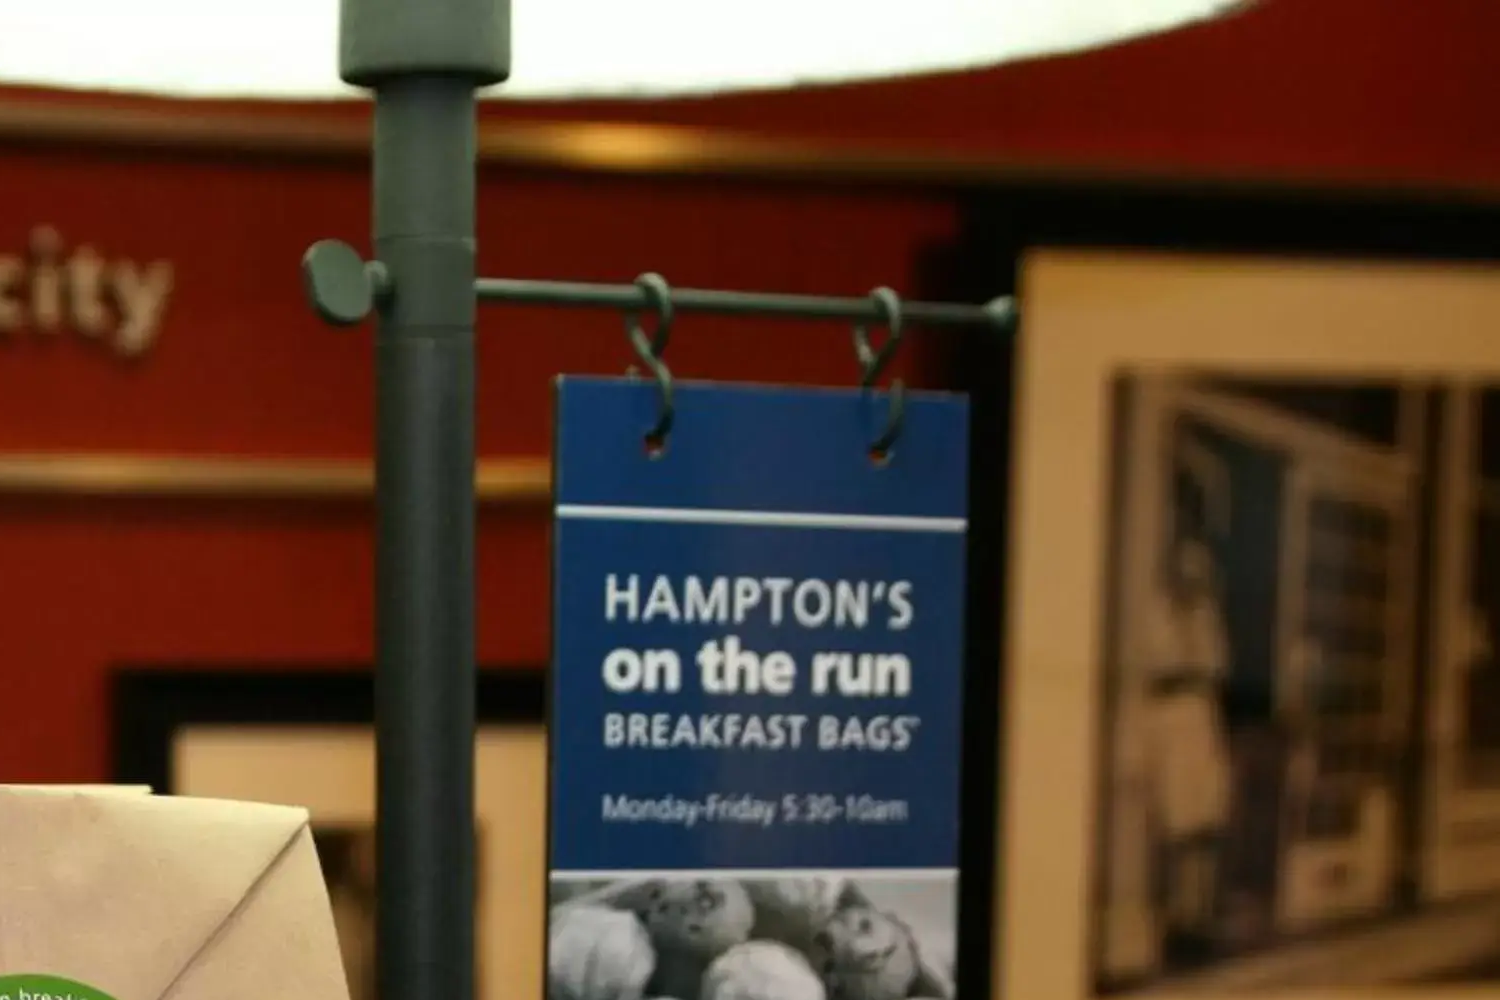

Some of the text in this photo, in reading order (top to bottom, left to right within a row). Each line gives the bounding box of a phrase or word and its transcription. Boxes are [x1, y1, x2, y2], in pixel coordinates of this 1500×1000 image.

[604, 573, 914, 631] HAMPTON'S
[602, 635, 912, 697] on the run
[604, 712, 808, 750] BREAKFAST
[602, 793, 777, 829] Monday-Friday
